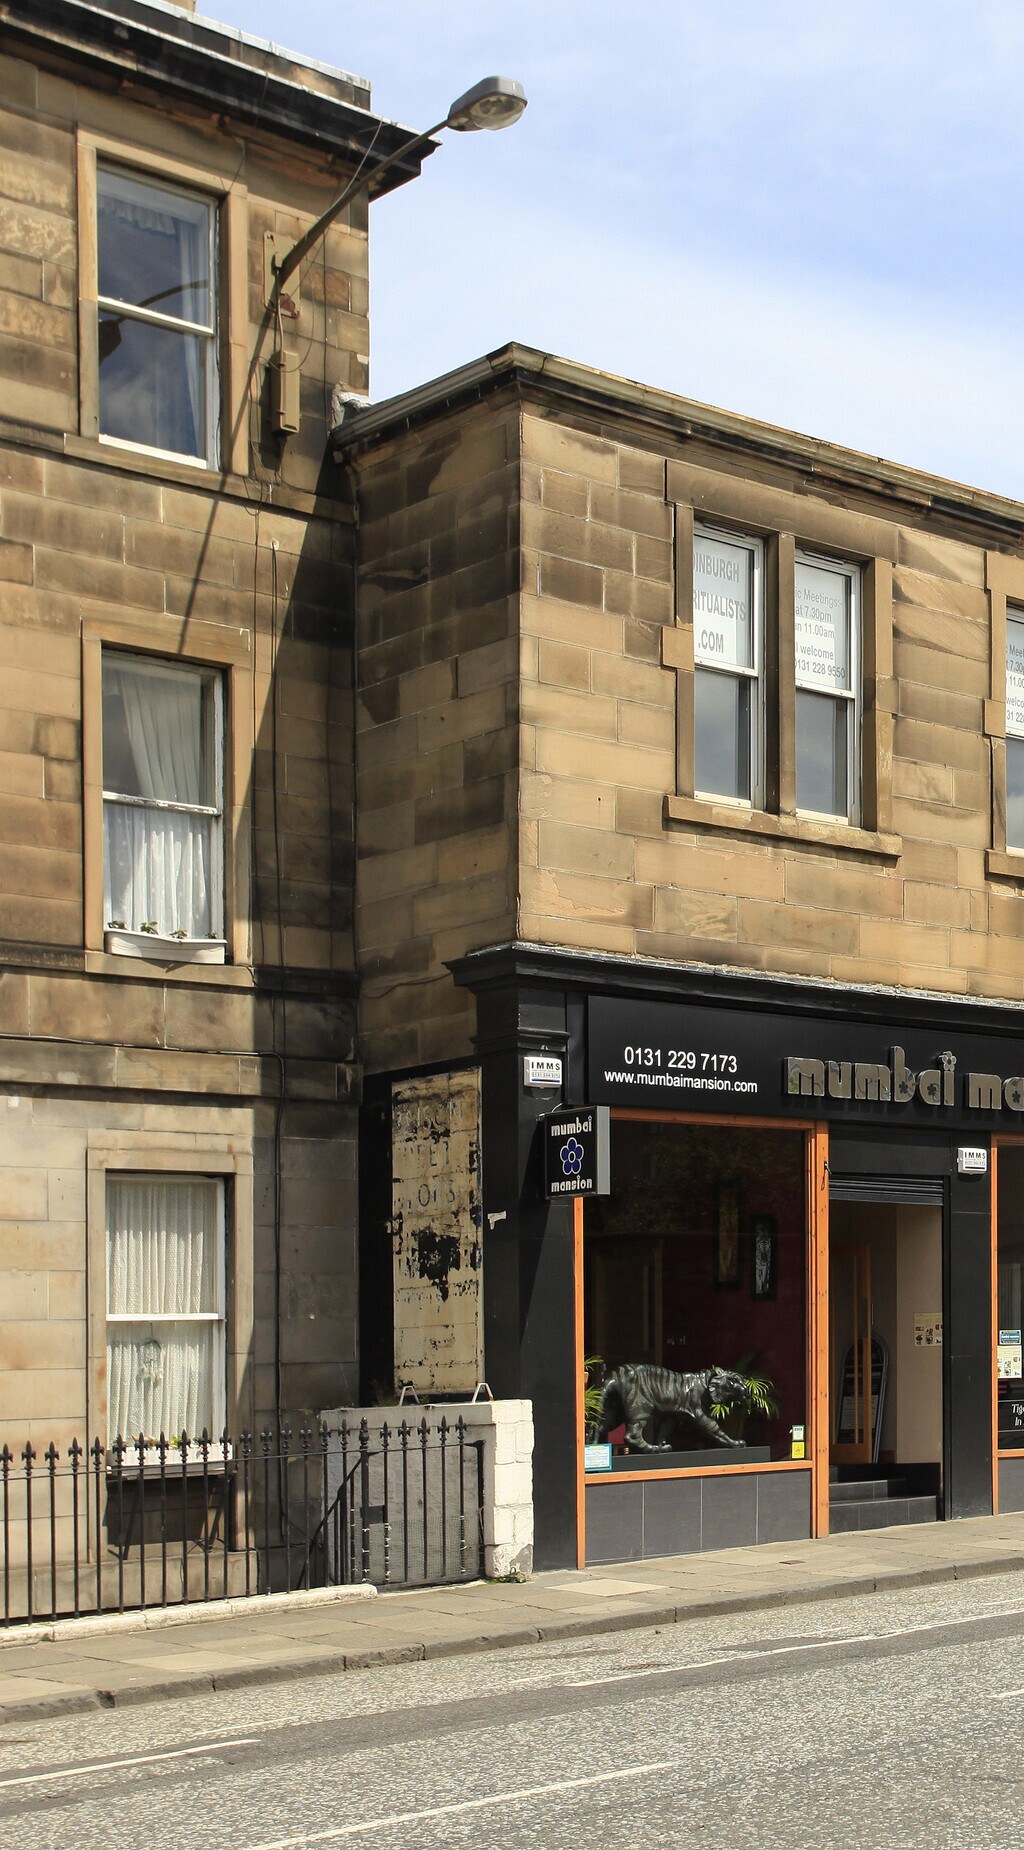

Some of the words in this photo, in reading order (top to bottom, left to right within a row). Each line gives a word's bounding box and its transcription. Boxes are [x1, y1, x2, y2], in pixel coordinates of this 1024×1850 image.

[805, 606, 832, 623] 7.30pm
[804, 623, 835, 639] 11.00am
[800, 645, 834, 660] welcome
[812, 661, 826, 675] 228
[828, 665, 846, 679] 9550
[624, 1046, 662, 1067] 0131
[667, 1050, 696, 1070] 229
[700, 1053, 738, 1074] 7173
[604, 1070, 758, 1093] www.mumbaimansion.com
[784, 1045, 957, 1107] mumbai
[551, 1115, 592, 1137] mumbai
[551, 1174, 592, 1192] mansion
[1015, 1417, 1022, 1426] In
